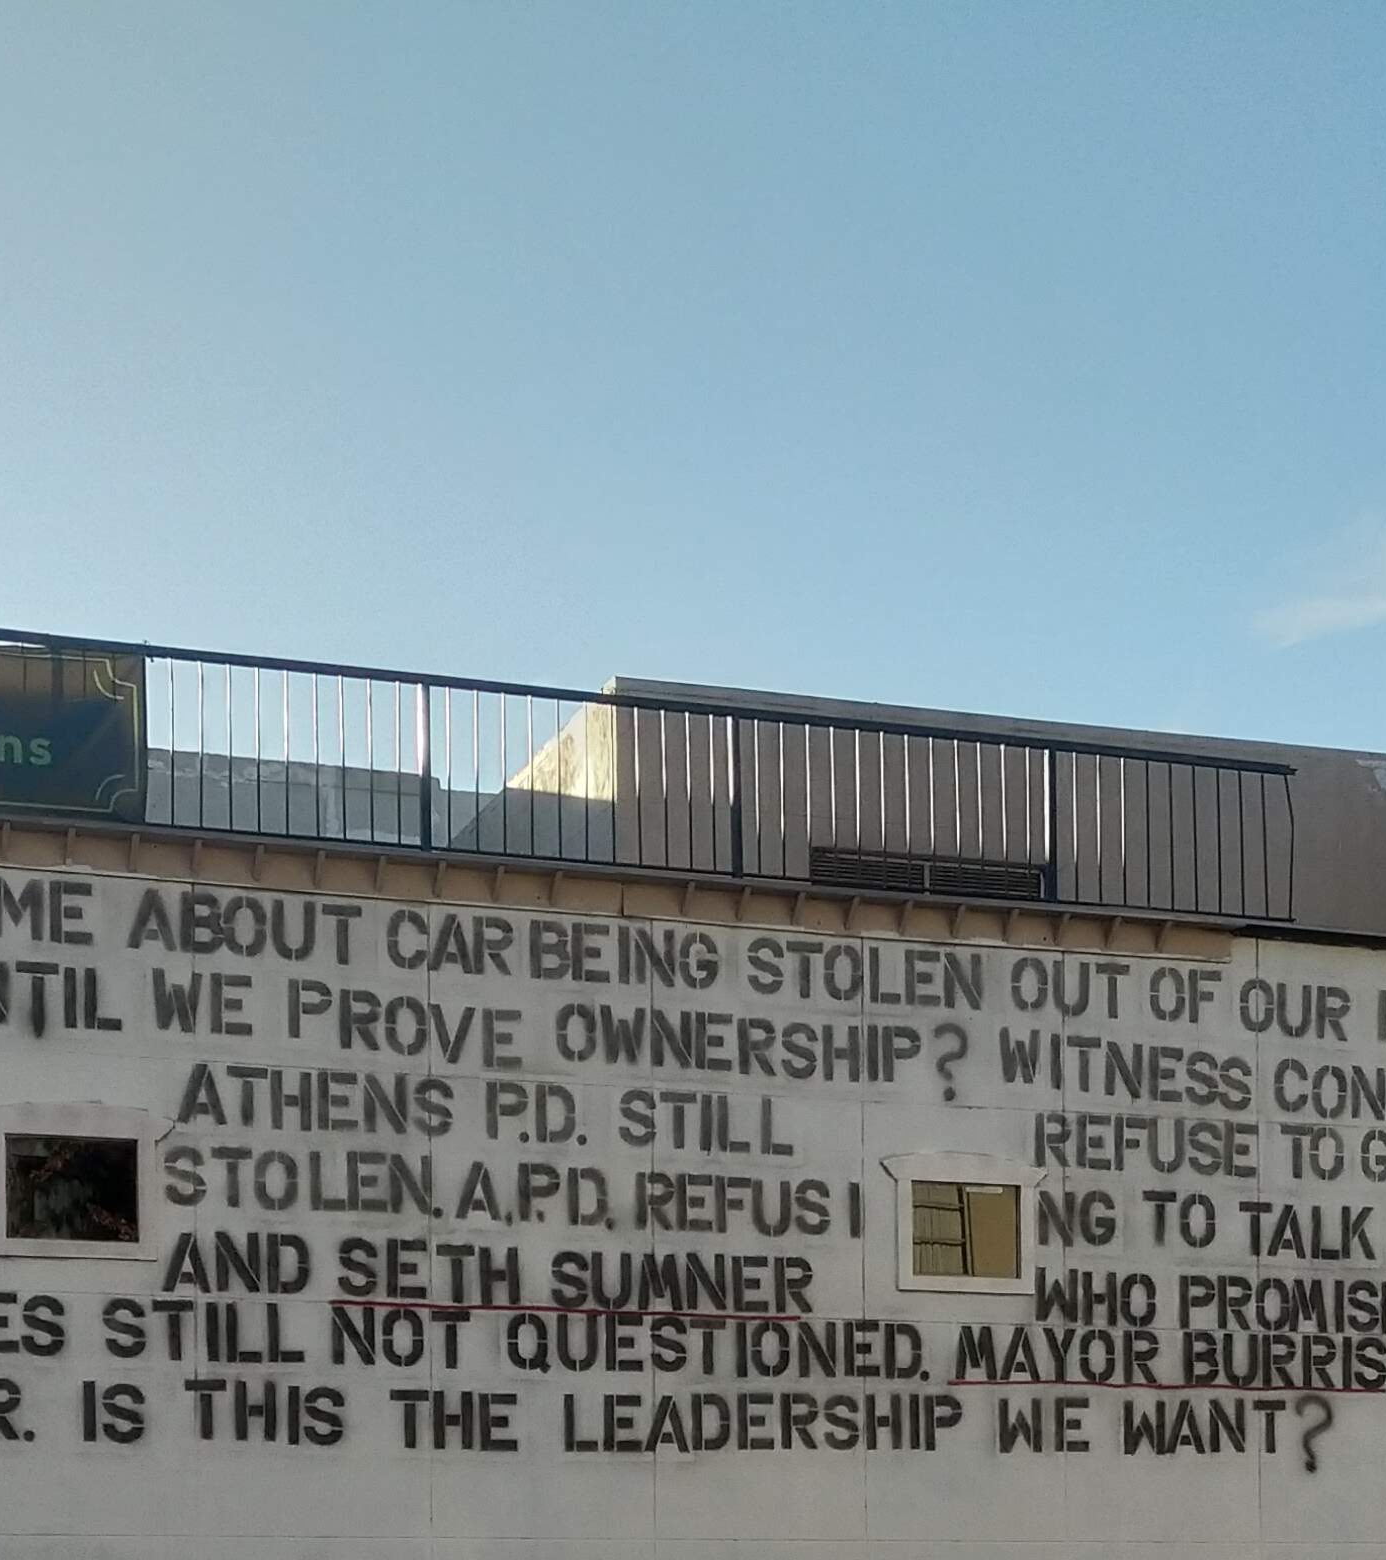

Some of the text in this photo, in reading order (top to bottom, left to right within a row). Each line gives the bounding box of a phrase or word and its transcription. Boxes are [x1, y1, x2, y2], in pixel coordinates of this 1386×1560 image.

[127, 888, 362, 966] ABOUT
[386, 909, 513, 975] CAR
[529, 919, 718, 989] BEING
[748, 937, 982, 1010] STOLEN
[1012, 957, 1129, 1019] OUT
[1150, 966, 1221, 1024] OF
[1240, 978, 1350, 1041] OUR
[152, 967, 253, 1036] WE
[288, 978, 522, 1069] PROVE
[999, 1026, 1252, 1110] WITNESS
[178, 1063, 454, 1137] ATHENS
[619, 1091, 793, 1155] STILL
[1034, 1112, 1256, 1178] REFUSE
[1281, 1124, 1344, 1180] TO
[1039, 1190, 1115, 1247] NG
[1143, 1190, 1216, 1248] TO
[1238, 1202, 1375, 1261] TALK
[162, 1231, 309, 1294] AND
[338, 1237, 520, 1304] SETH
[551, 1251, 813, 1313] SUMNER
[1035, 1267, 1156, 1327] WHO
[103, 1299, 304, 1363] STILL
[331, 1307, 470, 1369] NOT
[507, 1312, 930, 1381] QUESTIONED.
[956, 1326, 1159, 1385] MAYOR
[1183, 1332, 1386, 1389] BURRIS
[82, 1381, 145, 1444] IS
[185, 1379, 344, 1446] THIS
[390, 1390, 517, 1452] THE
[564, 1392, 963, 1452] LEADERSHIP
[998, 1398, 1090, 1454] WE
[1123, 1396, 1332, 1472] WANT?
